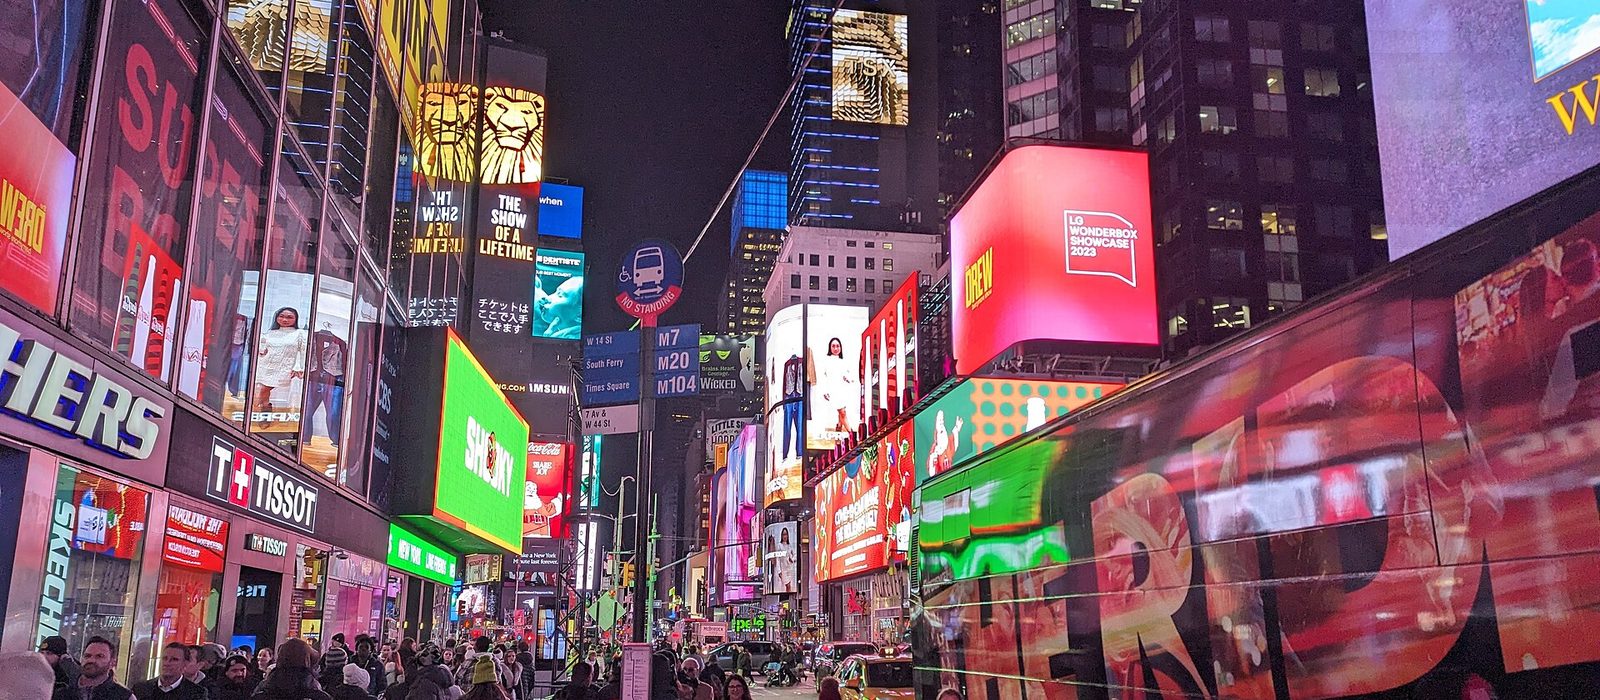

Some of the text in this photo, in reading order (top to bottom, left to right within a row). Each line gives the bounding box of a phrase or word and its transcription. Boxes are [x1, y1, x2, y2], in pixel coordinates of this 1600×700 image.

[844, 56, 896, 79] TSX
[498, 194, 522, 212] THE
[539, 197, 563, 206] when
[490, 209, 527, 229] SHOW
[1069, 216, 1083, 225] LG
[495, 226, 521, 243] OF A
[1069, 226, 1138, 239] WONDERBOX
[479, 239, 534, 262] LIFETIME
[1070, 237, 1130, 248] SHOWCASE
[1070, 247, 1097, 257] 2023
[965, 246, 993, 309] DREW
[478, 298, 529, 314] チケットは
[622, 291, 675, 314] NO STANDING
[478, 309, 529, 325] ここで入手
[482, 320, 523, 334] できます
[596, 336, 604, 345] 14
[605, 336, 613, 344] St
[659, 329, 680, 347] M7
[586, 358, 624, 370] South Ferry
[658, 351, 690, 371] M20
[0, 322, 166, 460] HERS
[585, 382, 630, 393] Times Square
[657, 375, 696, 395] M104
[379, 378, 391, 415] CBS
[591, 410, 600, 418] Av
[602, 409, 607, 417] &
[585, 421, 592, 429] W
[711, 420, 735, 433] LITTLE
[254, 464, 317, 527] TISSOT
[263, 536, 288, 557] TISSOT
